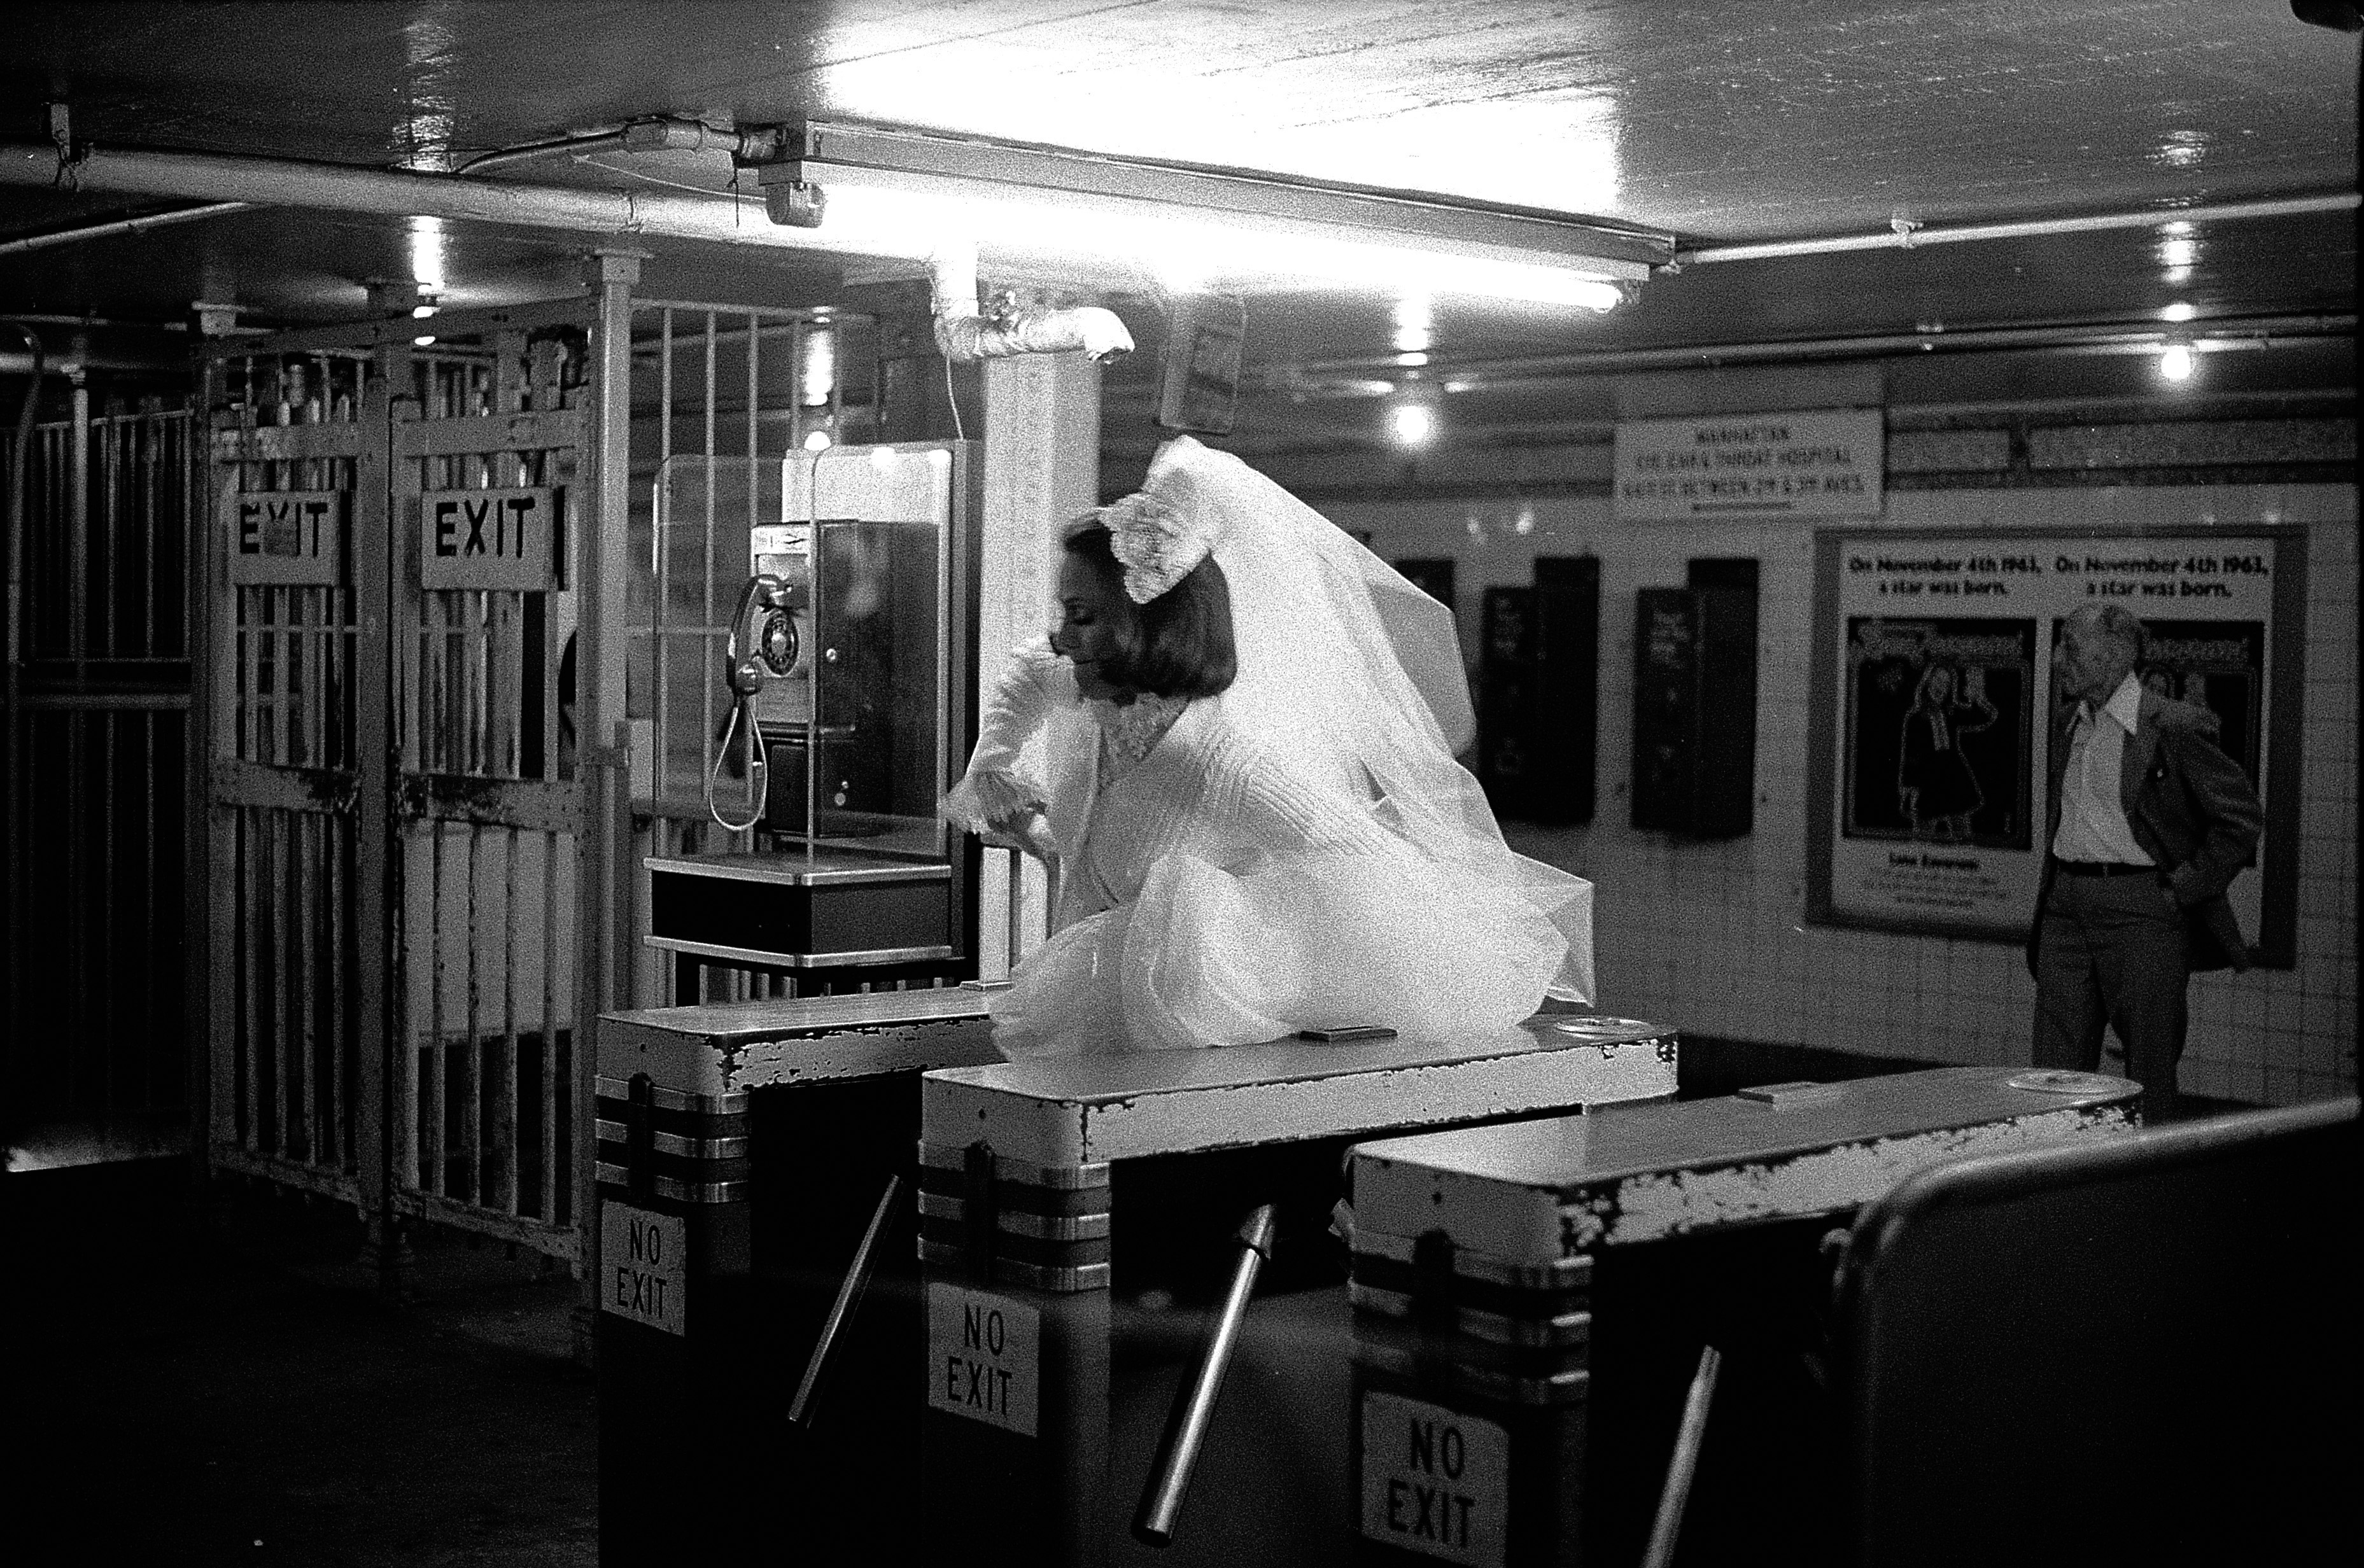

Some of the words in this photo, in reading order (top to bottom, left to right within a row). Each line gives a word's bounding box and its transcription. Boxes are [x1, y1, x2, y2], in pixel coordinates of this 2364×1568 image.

[436, 497, 536, 558] EXIT
[1850, 557, 1872, 572] On
[1877, 557, 1962, 572] November
[1968, 556, 1997, 572] 4th
[2055, 556, 2081, 572] On
[2085, 555, 2181, 573] November
[2183, 556, 2218, 573] 4th
[2101, 580, 2137, 596] star
[2142, 582, 2176, 596] was
[2181, 580, 2234, 598] born.
[630, 1218, 661, 1265] NO
[617, 1266, 668, 1319] EXIT
[964, 1304, 1004, 1356] NO
[948, 1355, 1013, 1417] EXIT
[1411, 1418, 1464, 1480] NO
[1388, 1477, 1475, 1549] EXIT
